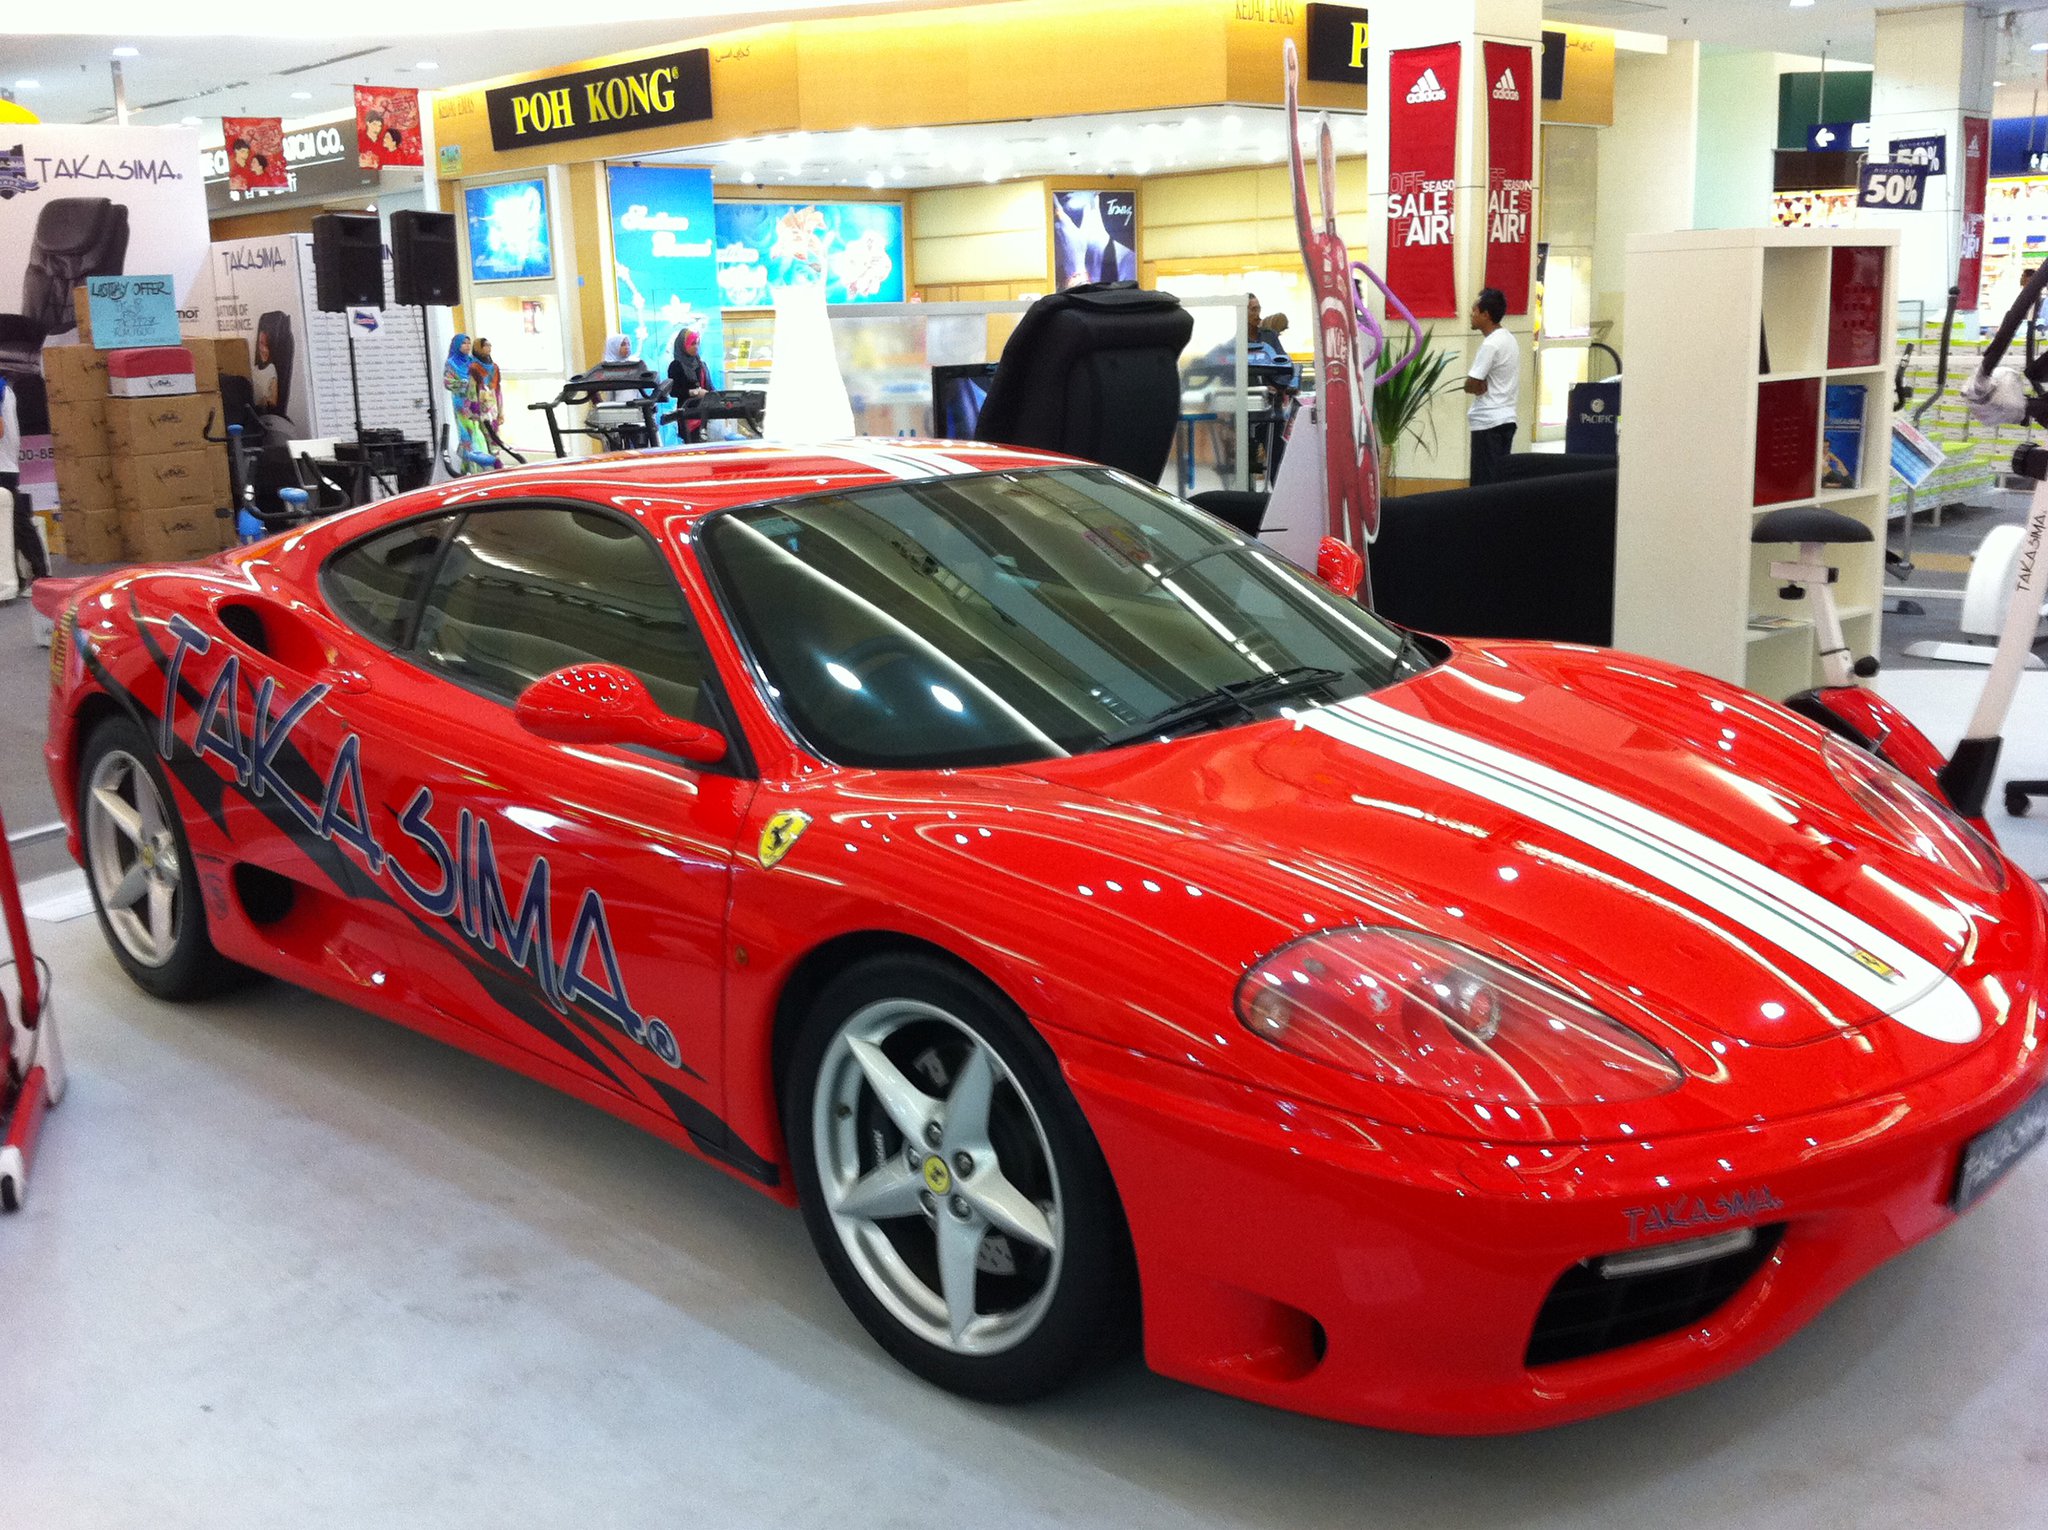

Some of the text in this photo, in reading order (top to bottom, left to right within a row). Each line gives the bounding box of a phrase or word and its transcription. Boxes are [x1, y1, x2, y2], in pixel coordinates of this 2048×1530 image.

[511, 66, 676, 135] POH KONG
[1406, 90, 1447, 104] adidas
[1492, 88, 1519, 101] adidas
[316, 127, 345, 156] CO.
[1865, 174, 1918, 204] 50%
[1581, 413, 1615, 424] PACIFIC
[1621, 1183, 1784, 1243] TAKASIMA
